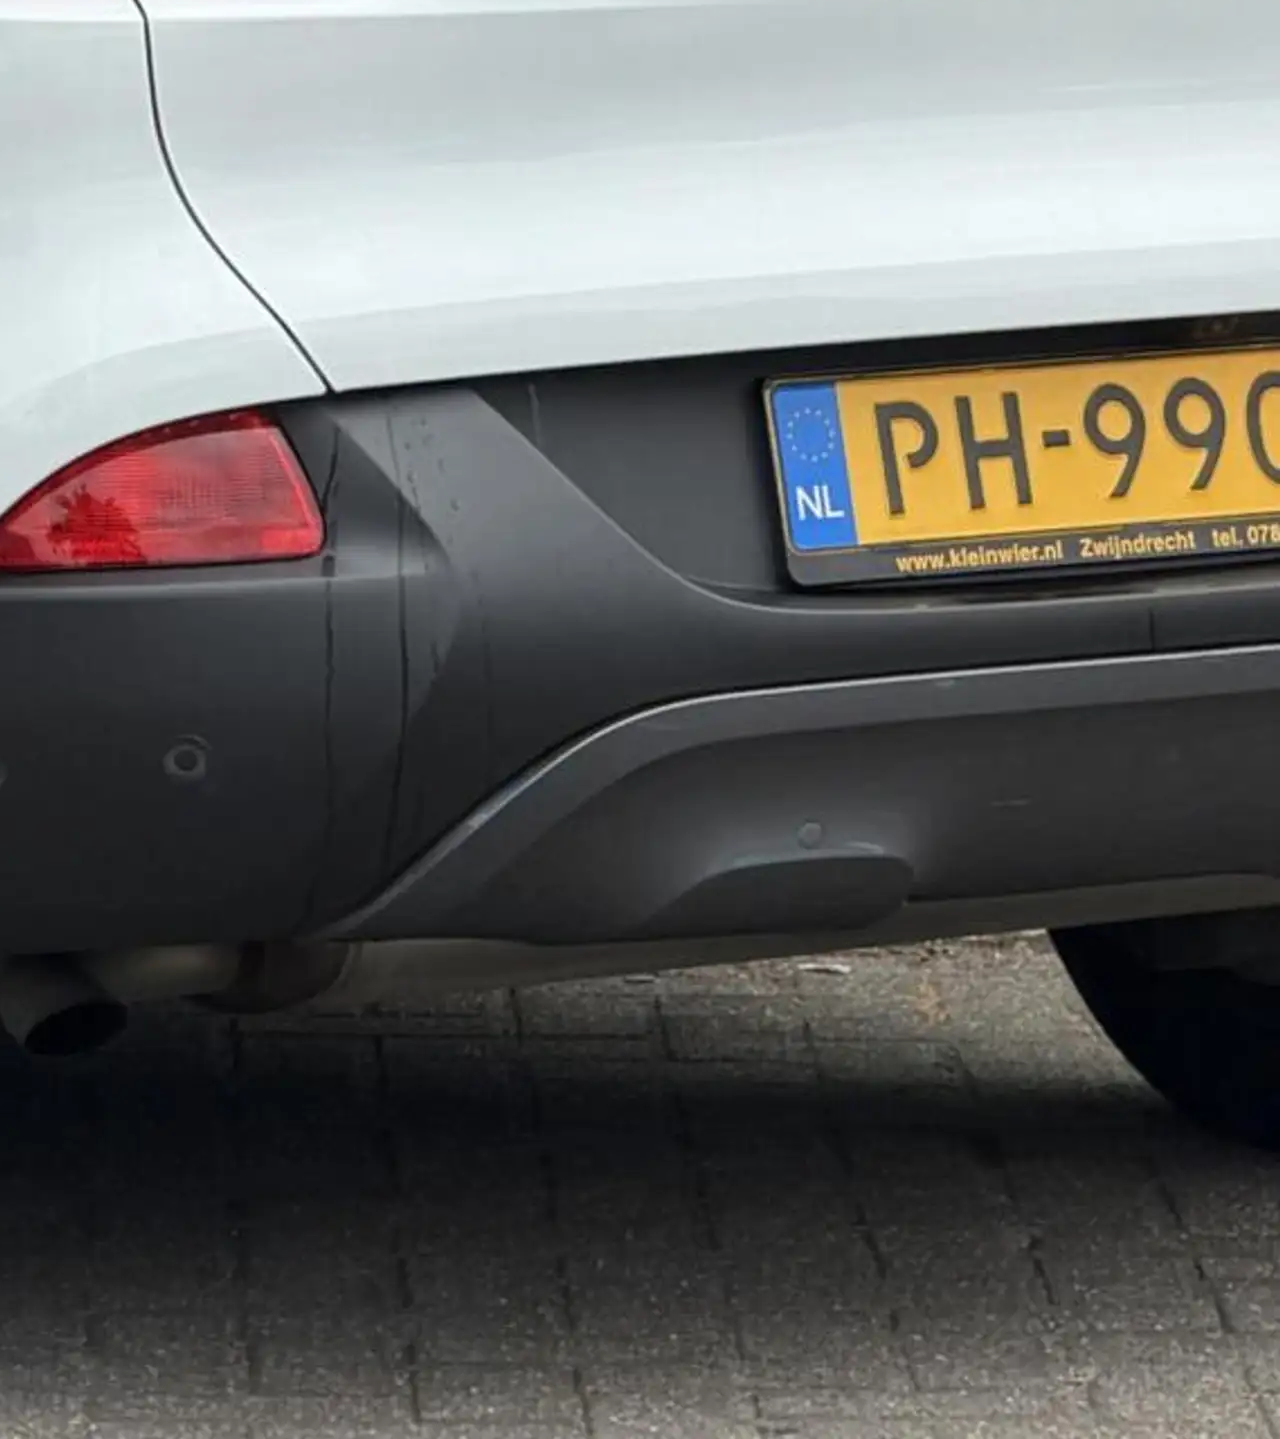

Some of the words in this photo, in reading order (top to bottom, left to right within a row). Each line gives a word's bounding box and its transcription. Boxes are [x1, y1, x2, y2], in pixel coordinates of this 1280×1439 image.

[796, 486, 844, 521] NL
[896, 539, 1064, 573] www.kleinwier.nl
[1079, 530, 1196, 560] Zwijndrecht
[1212, 527, 1243, 548] tel.
